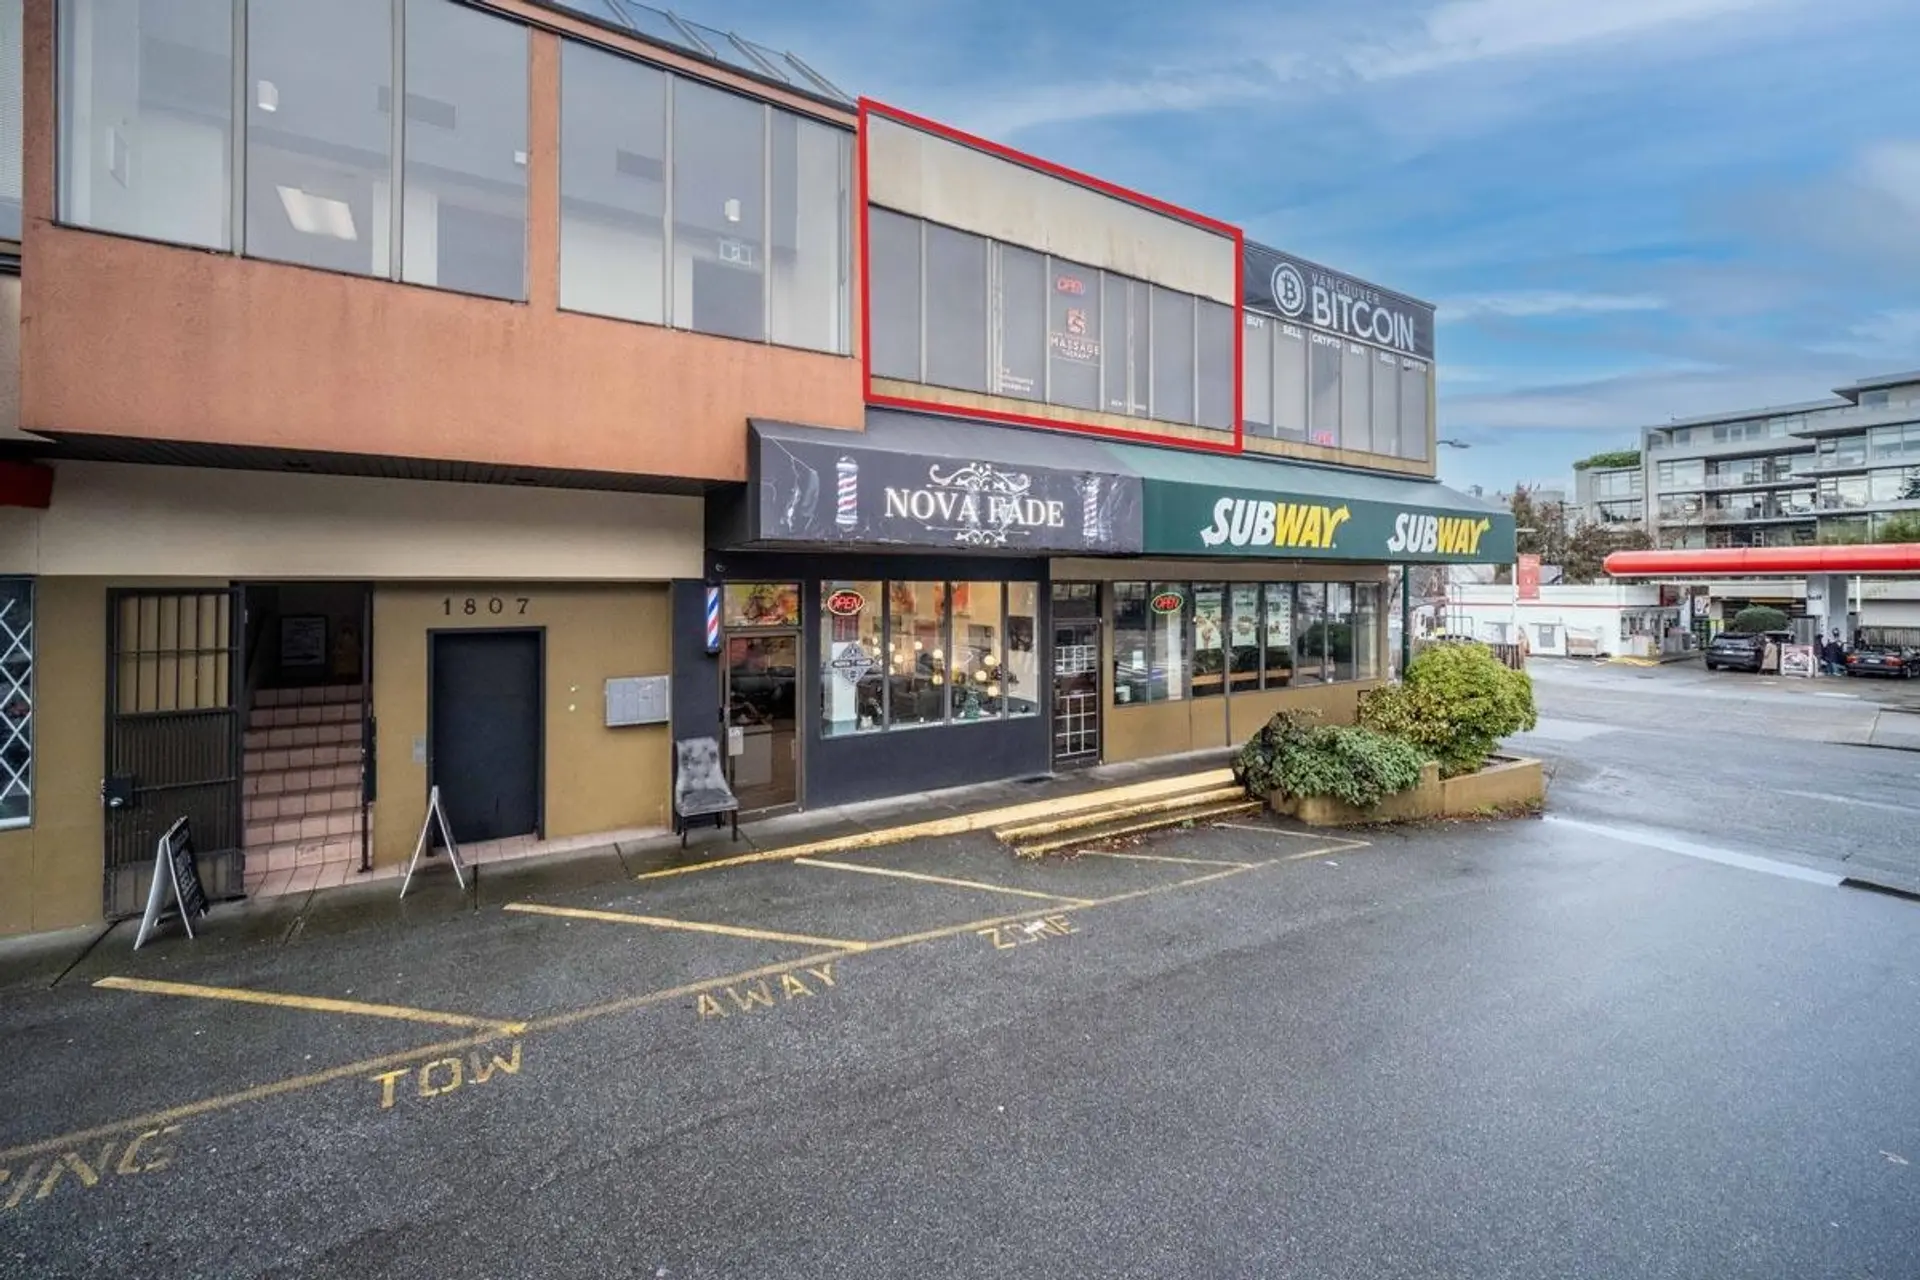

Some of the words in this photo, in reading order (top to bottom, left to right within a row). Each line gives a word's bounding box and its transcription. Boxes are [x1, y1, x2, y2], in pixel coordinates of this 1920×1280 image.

[1246, 314, 1265, 329] BUY
[1283, 324, 1303, 340] SELL
[1312, 285, 1415, 352] BITCOIN
[1050, 336, 1101, 356] MASSAGE
[1312, 333, 1341, 349] CRYPTO
[884, 486, 982, 523] NOVA
[987, 494, 1065, 528] FADE
[1200, 497, 1350, 549] SUBWAY
[1387, 512, 1491, 555] SUBWAY
[443, 597, 530, 616] 1807
[833, 595, 862, 611] OPEN
[1155, 594, 1180, 610] OPEN
[697, 963, 836, 1018] AWAY
[367, 1041, 523, 1110] TOW
[0, 1124, 184, 1209] ING
